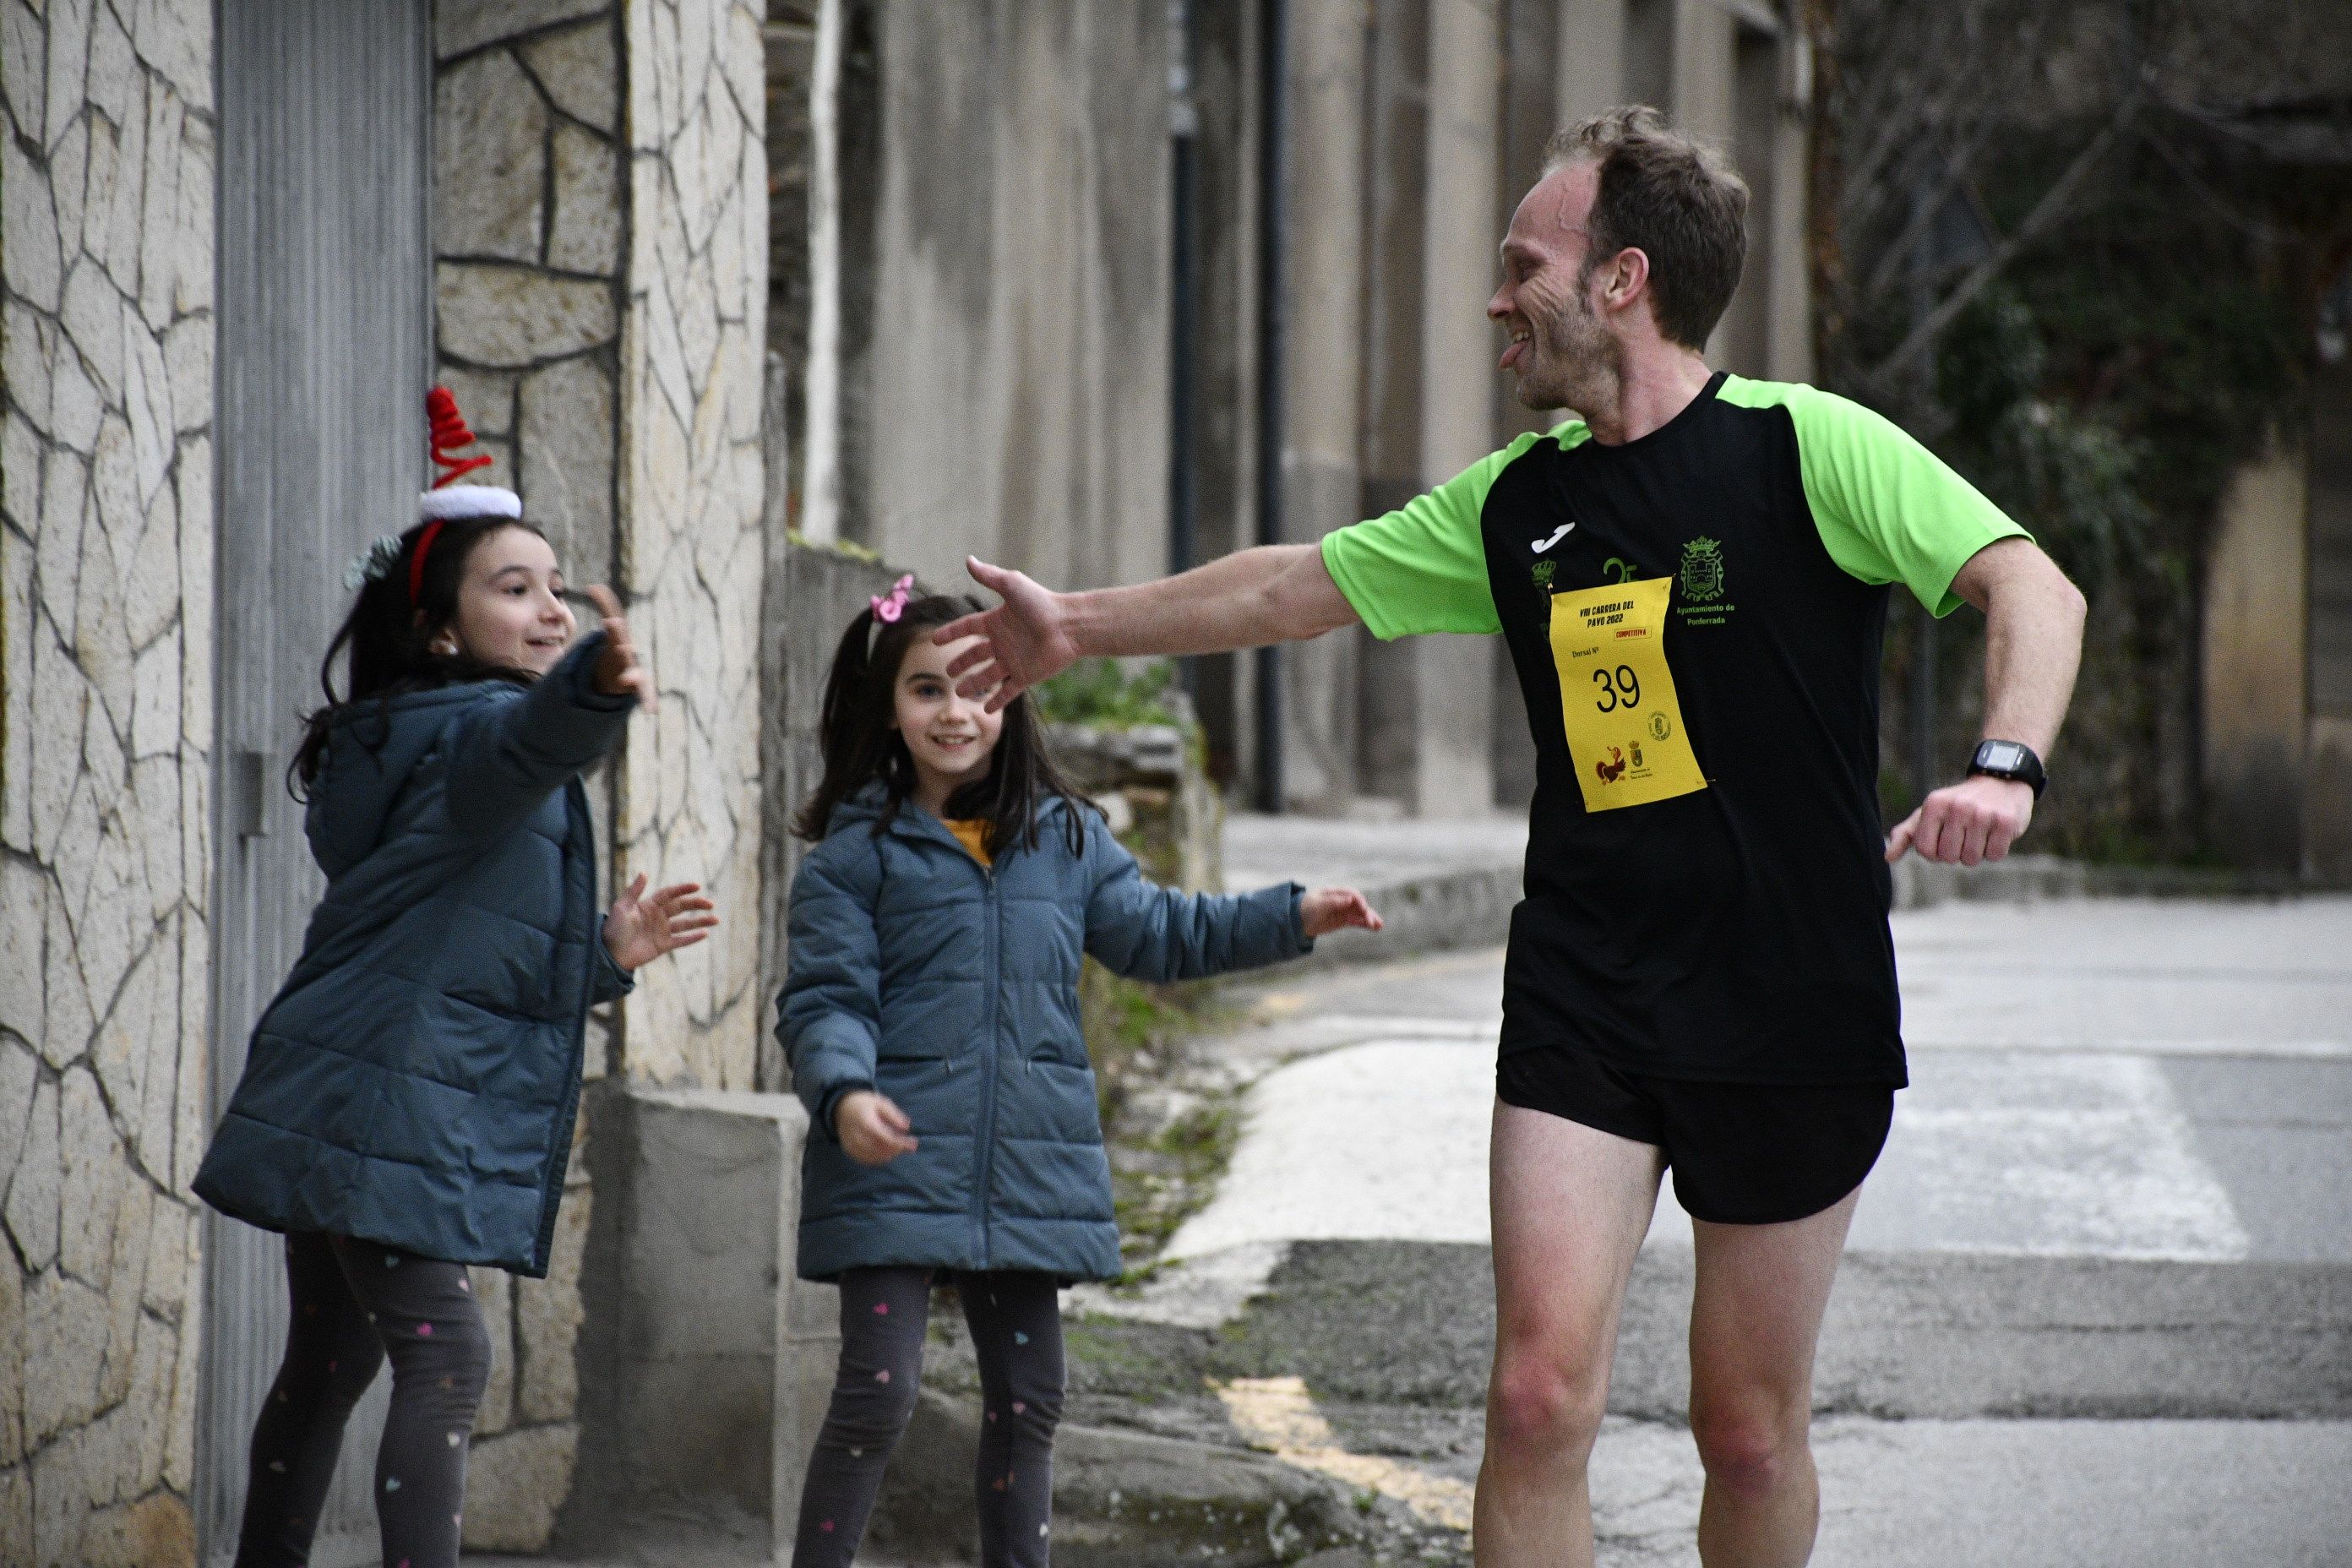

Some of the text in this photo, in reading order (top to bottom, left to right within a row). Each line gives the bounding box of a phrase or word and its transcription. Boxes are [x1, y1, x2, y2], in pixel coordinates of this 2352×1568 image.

[1580, 600, 1634, 618] VIII CARRERA DEL
[1677, 605, 1723, 615] Ayuntamiento
[1587, 613, 1624, 628] PAVO 2022
[1687, 617, 1725, 625] Ponferrada
[1615, 629, 1647, 638] COMPETITIVA
[1572, 648, 1592, 658] Dorsal
[1593, 665, 1640, 712] 39
